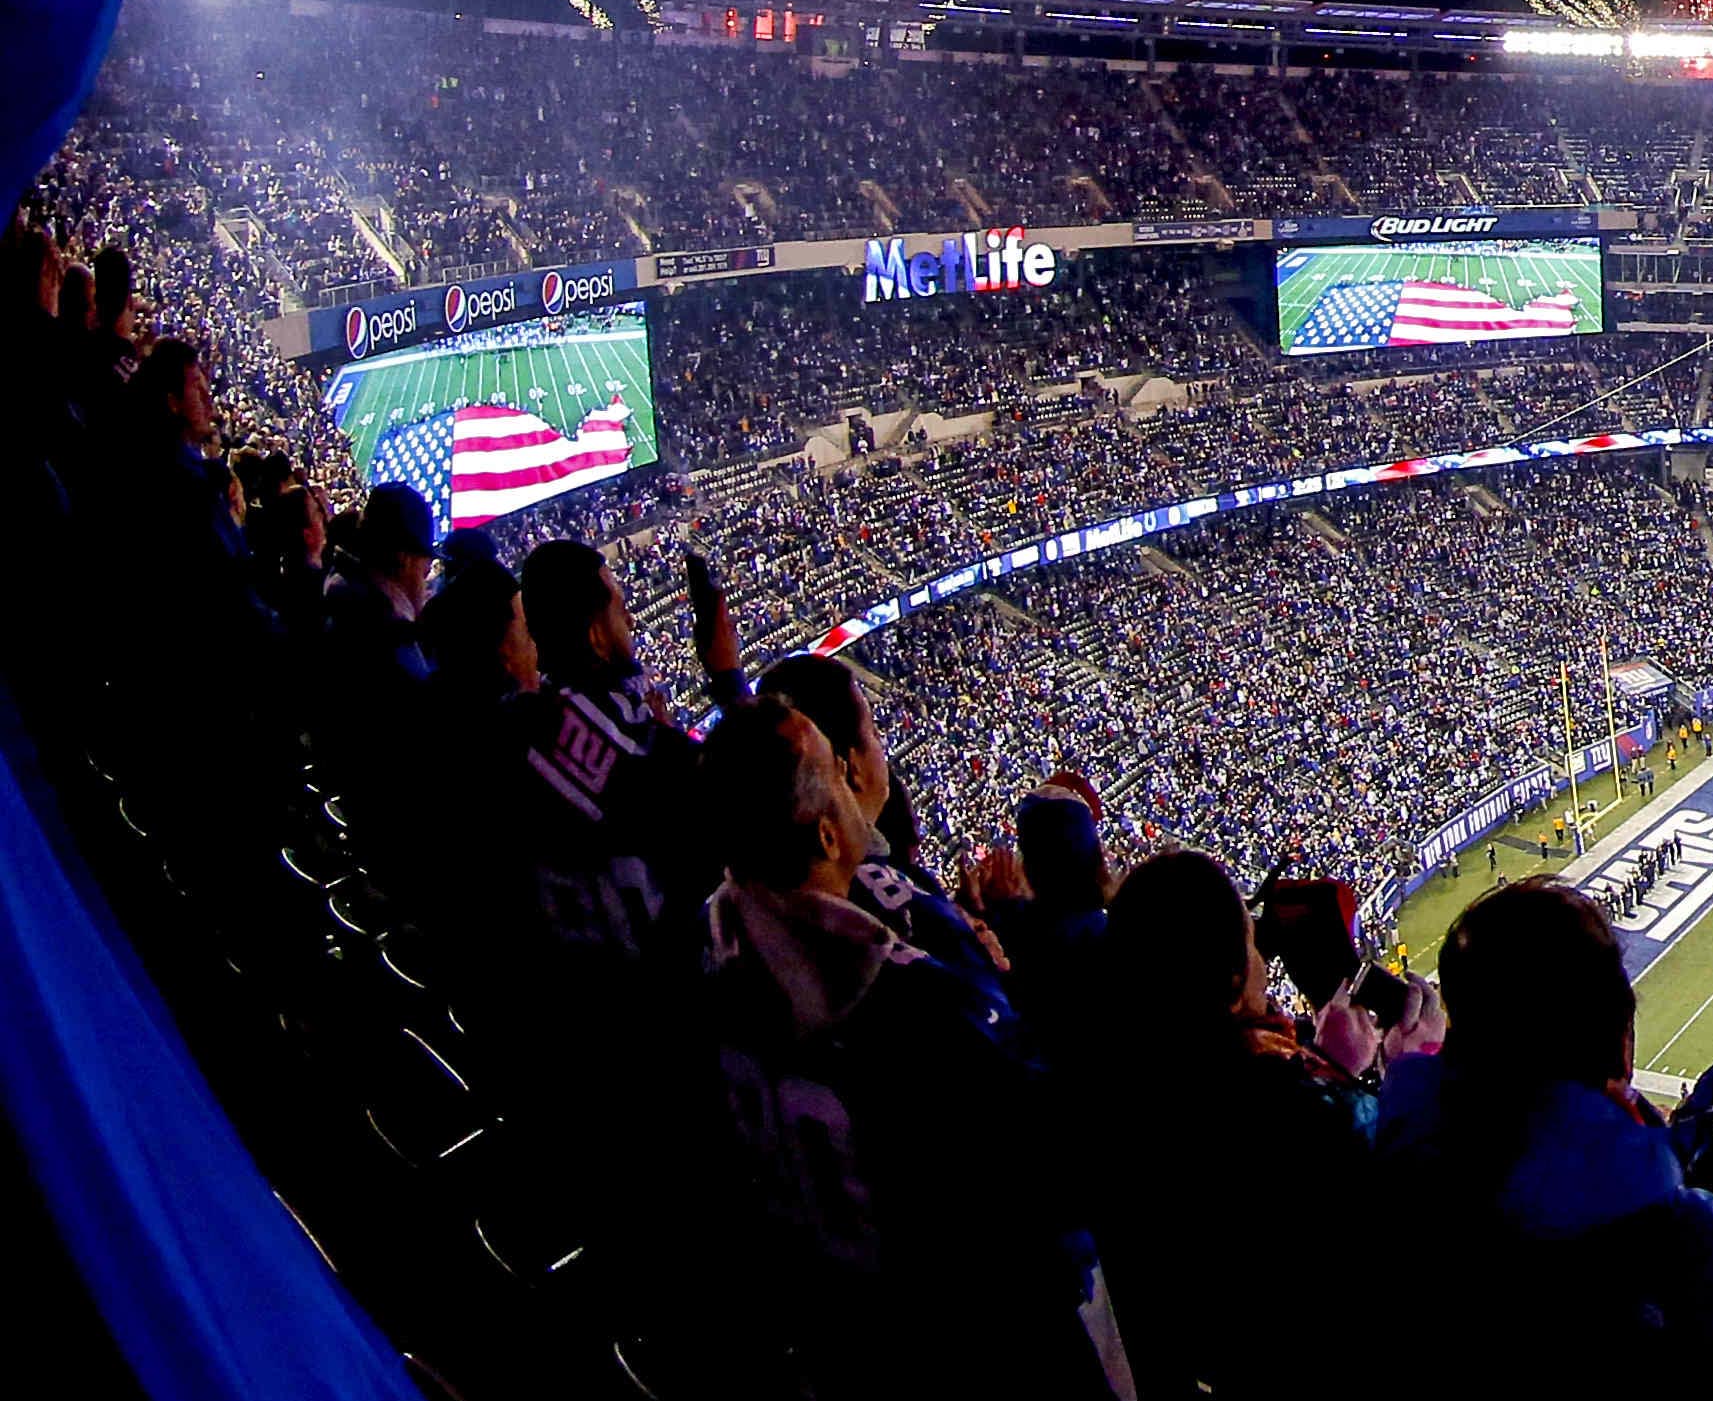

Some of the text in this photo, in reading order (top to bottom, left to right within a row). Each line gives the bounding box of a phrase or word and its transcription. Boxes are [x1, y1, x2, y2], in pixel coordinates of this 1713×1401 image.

[864, 225, 1056, 304] MetLife
[467, 281, 516, 321] pepsi
[564, 268, 614, 303] pepsi
[369, 300, 417, 341] pepsi
